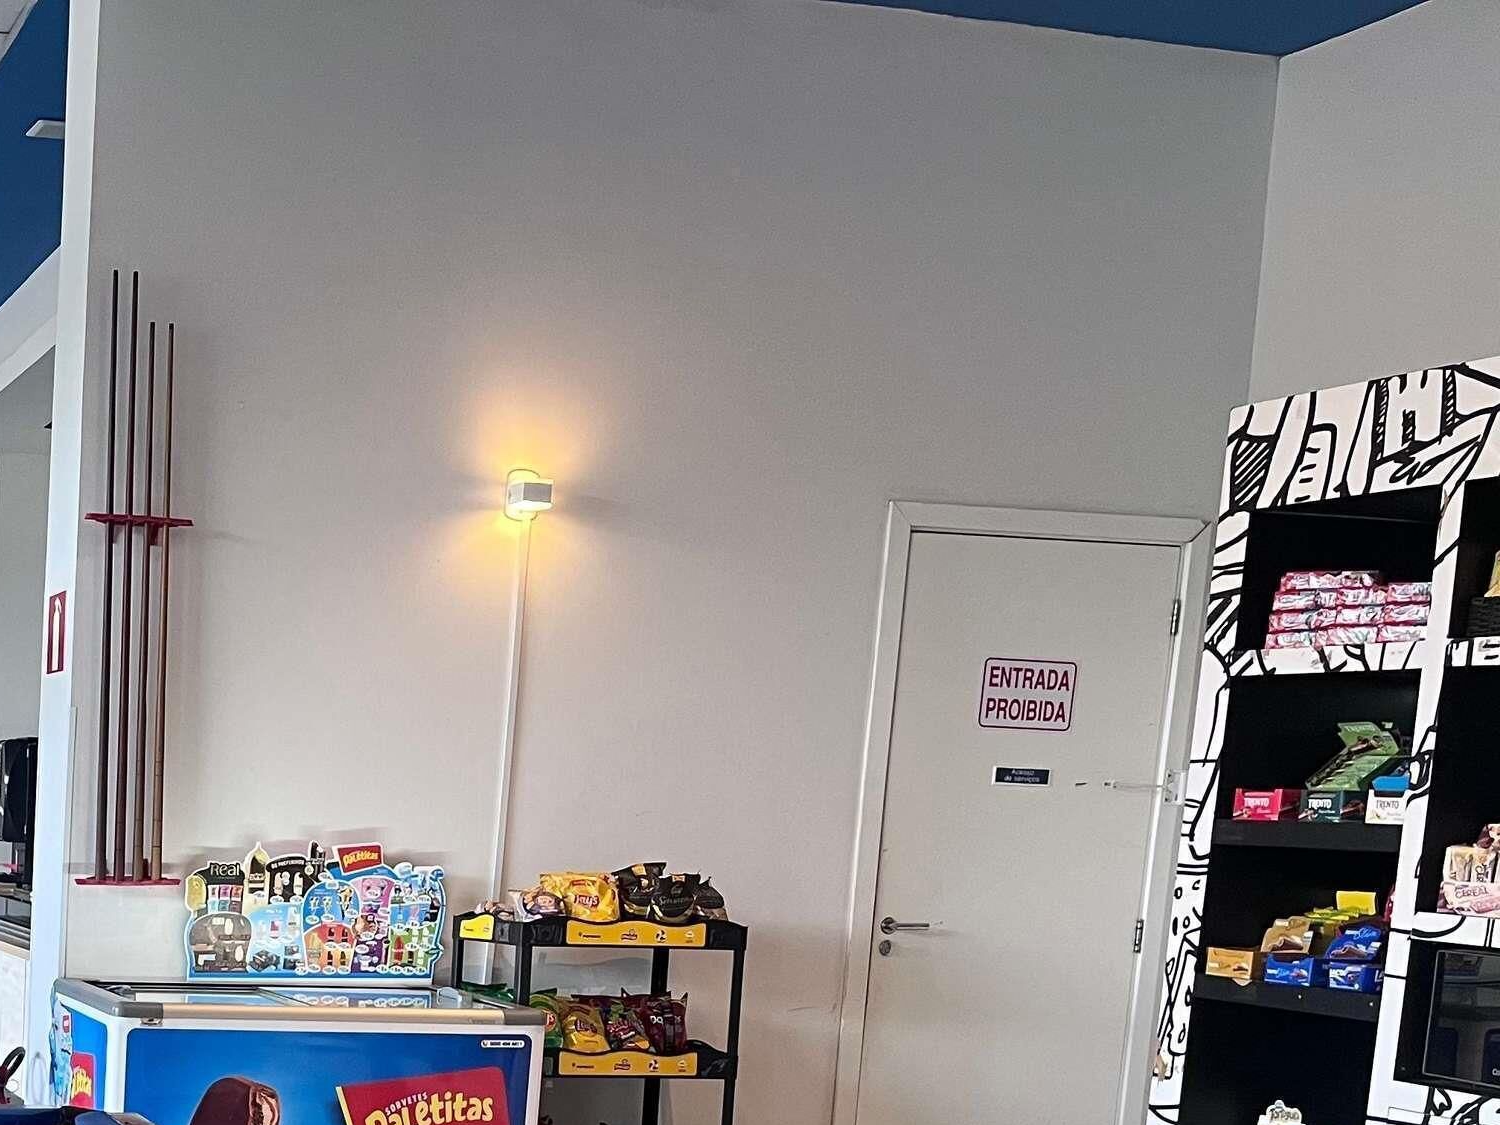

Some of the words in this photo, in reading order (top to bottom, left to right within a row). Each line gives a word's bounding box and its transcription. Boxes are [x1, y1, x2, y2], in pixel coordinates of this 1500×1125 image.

[988, 666, 1070, 691] ENTRADA
[985, 698, 1067, 723] PROIBIDA
[1243, 797, 1270, 808] TRENTO
[1307, 798, 1332, 809] TRENTO
[1375, 799, 1400, 810] TRENTO
[210, 862, 241, 877] Real
[385, 1091, 429, 1116] SORVETES
